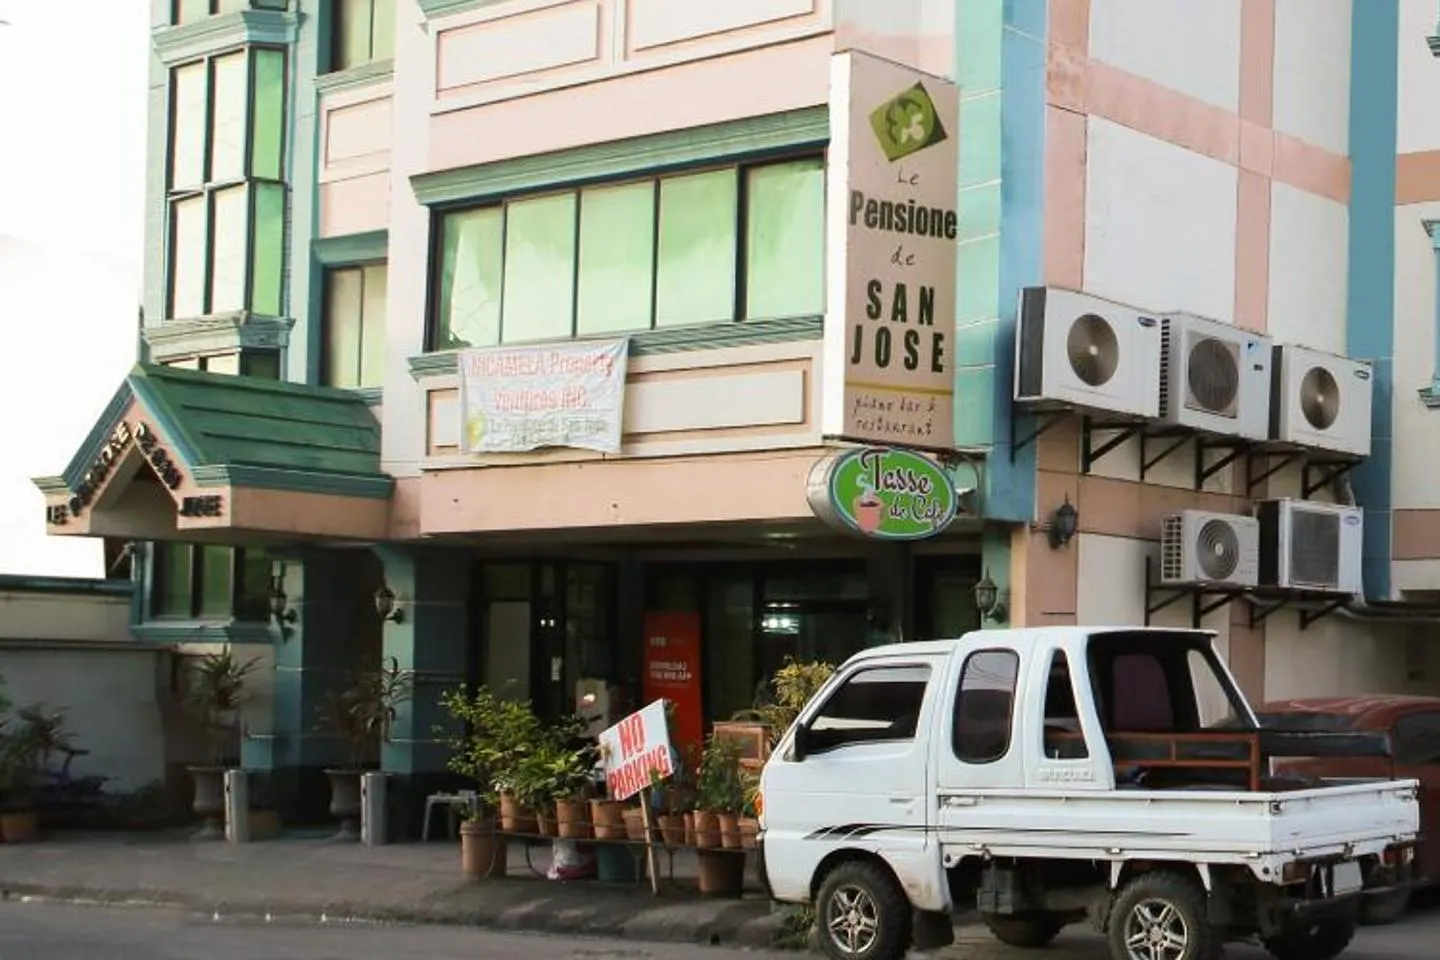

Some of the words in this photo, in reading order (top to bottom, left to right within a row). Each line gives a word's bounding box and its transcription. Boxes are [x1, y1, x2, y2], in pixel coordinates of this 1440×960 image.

[897, 168, 919, 185] Le
[849, 190, 957, 240] Pensione
[890, 245, 916, 266] de
[866, 278, 934, 326] SAN
[851, 324, 944, 373] JOSE
[860, 447, 930, 494] Tasse
[618, 713, 645, 759] NO
[609, 744, 669, 800] PARKING
